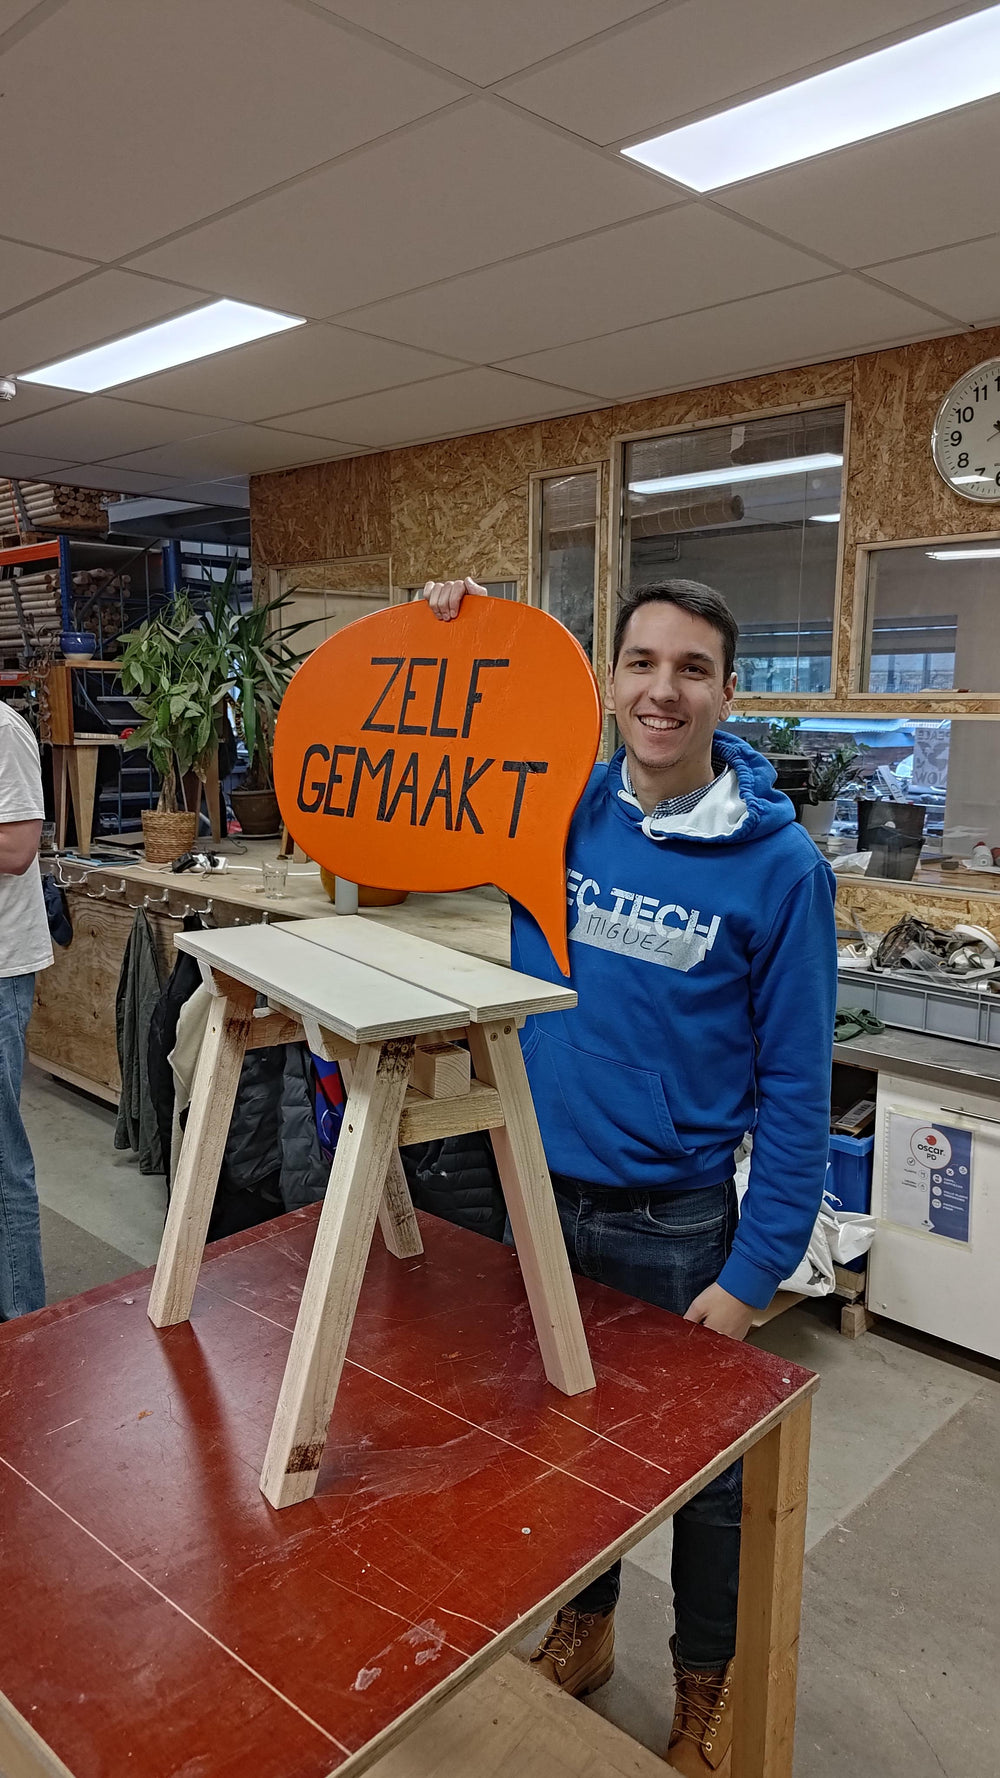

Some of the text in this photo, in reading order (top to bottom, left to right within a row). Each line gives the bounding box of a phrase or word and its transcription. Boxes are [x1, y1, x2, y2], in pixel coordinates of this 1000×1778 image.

[973, 384, 988, 402] 11
[955, 406, 974, 424] 10
[950, 430, 963, 447] 9
[957, 452, 969, 469] 8
[360, 656, 511, 739] ZELF
[297, 743, 549, 839] GEMAAKT
[610, 887, 722, 952] TECH
[586, 914, 673, 957] MIGUEL
[917, 1143, 944, 1156] oscar
